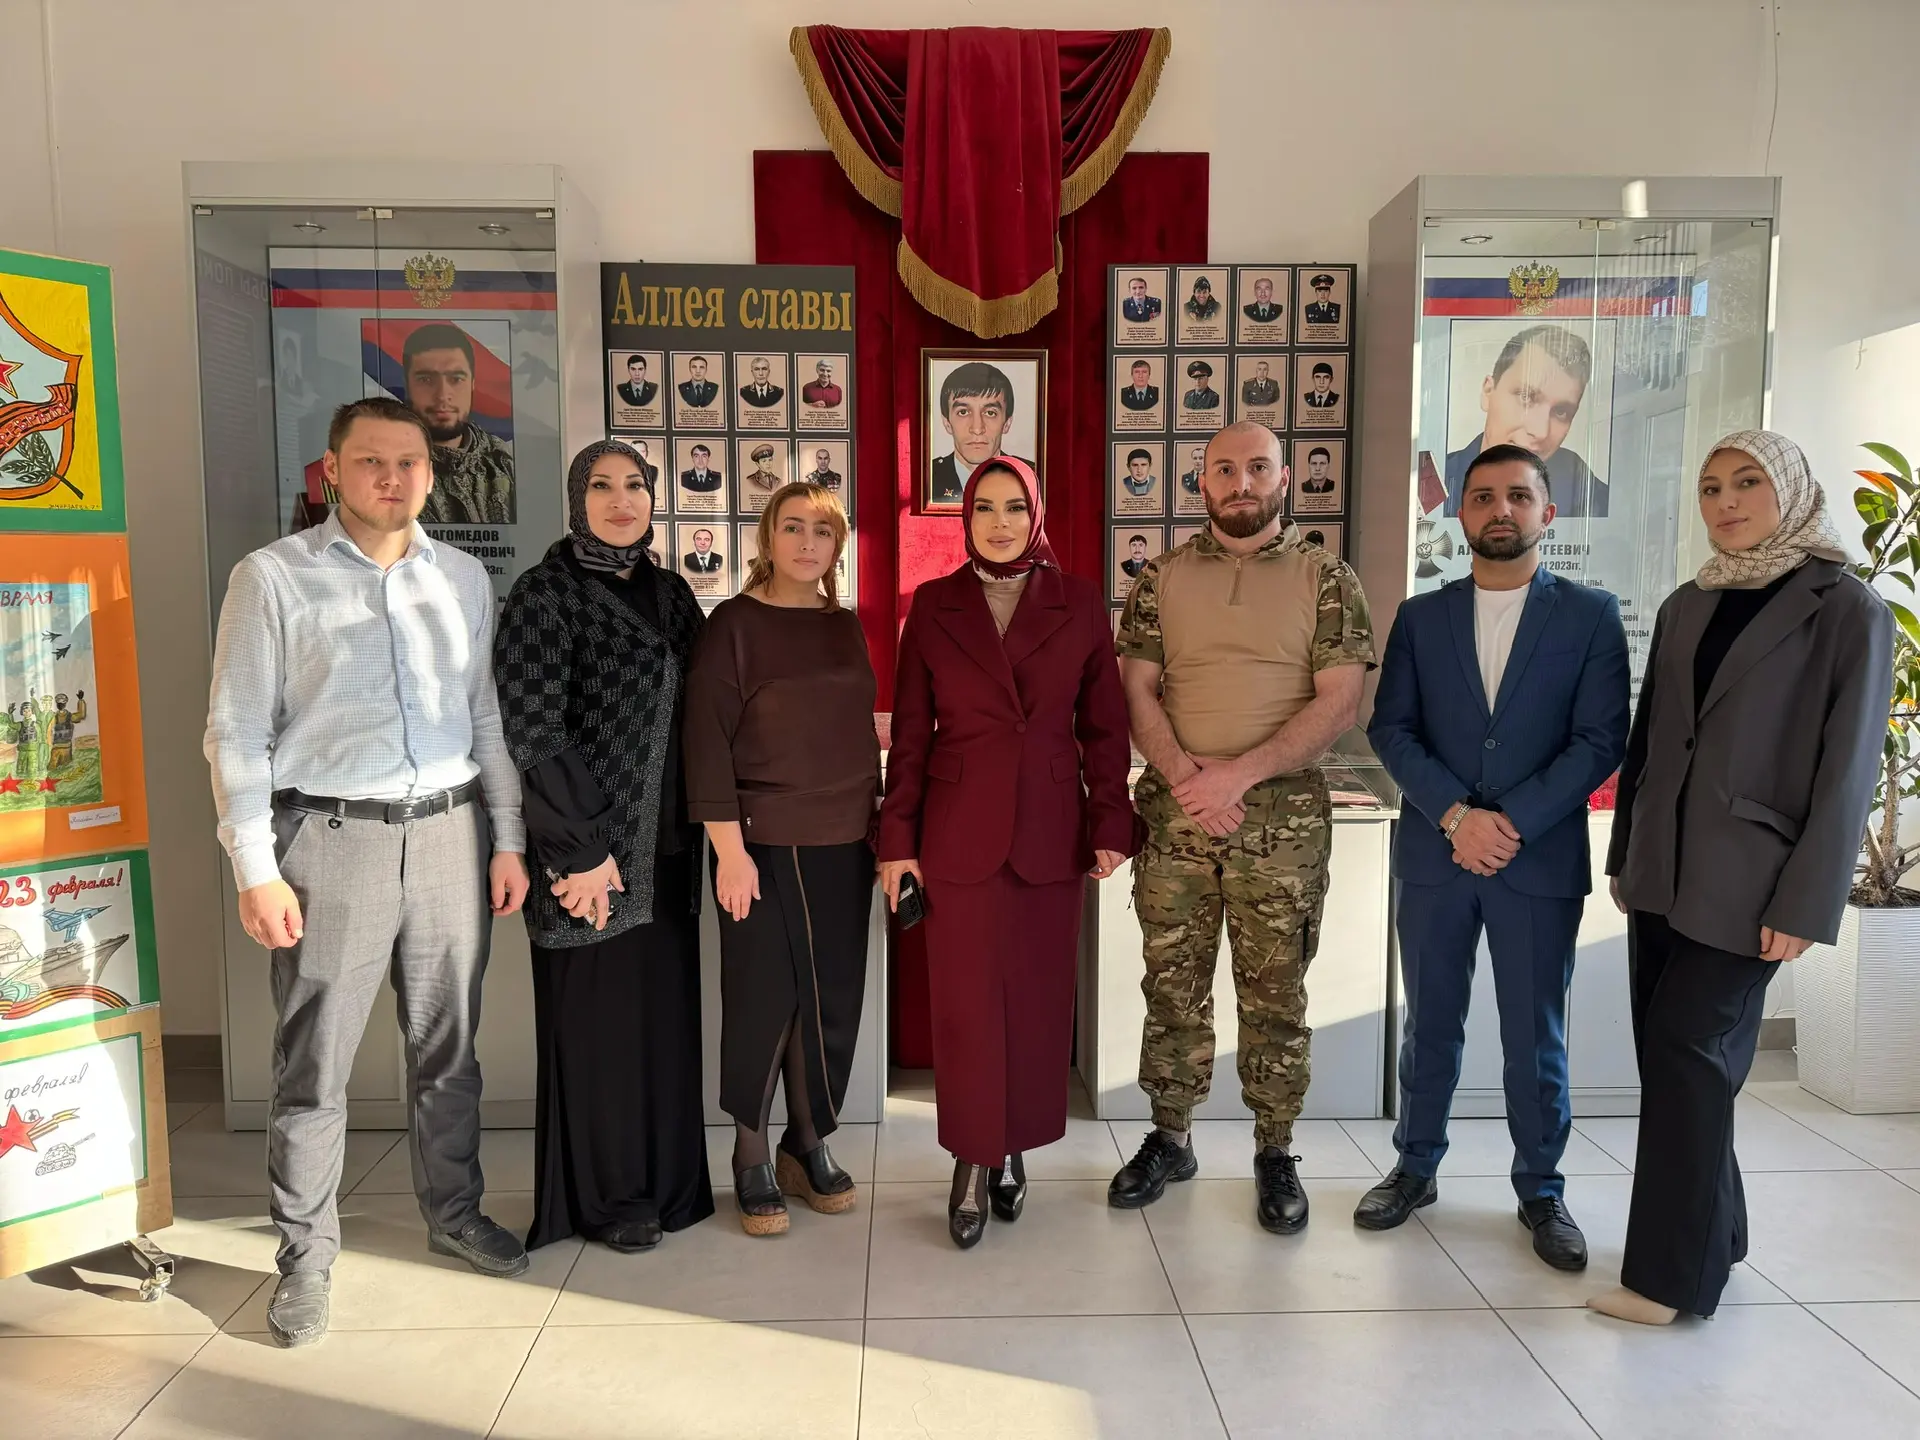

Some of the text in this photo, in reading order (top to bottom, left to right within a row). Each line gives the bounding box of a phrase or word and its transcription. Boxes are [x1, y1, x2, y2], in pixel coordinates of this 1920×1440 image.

[611, 271, 852, 331] Аллея славы
[0, 590, 53, 607] ВРАЛЯ
[47, 867, 123, 904] февраля!
[4, 1062, 89, 1107] февраля!
